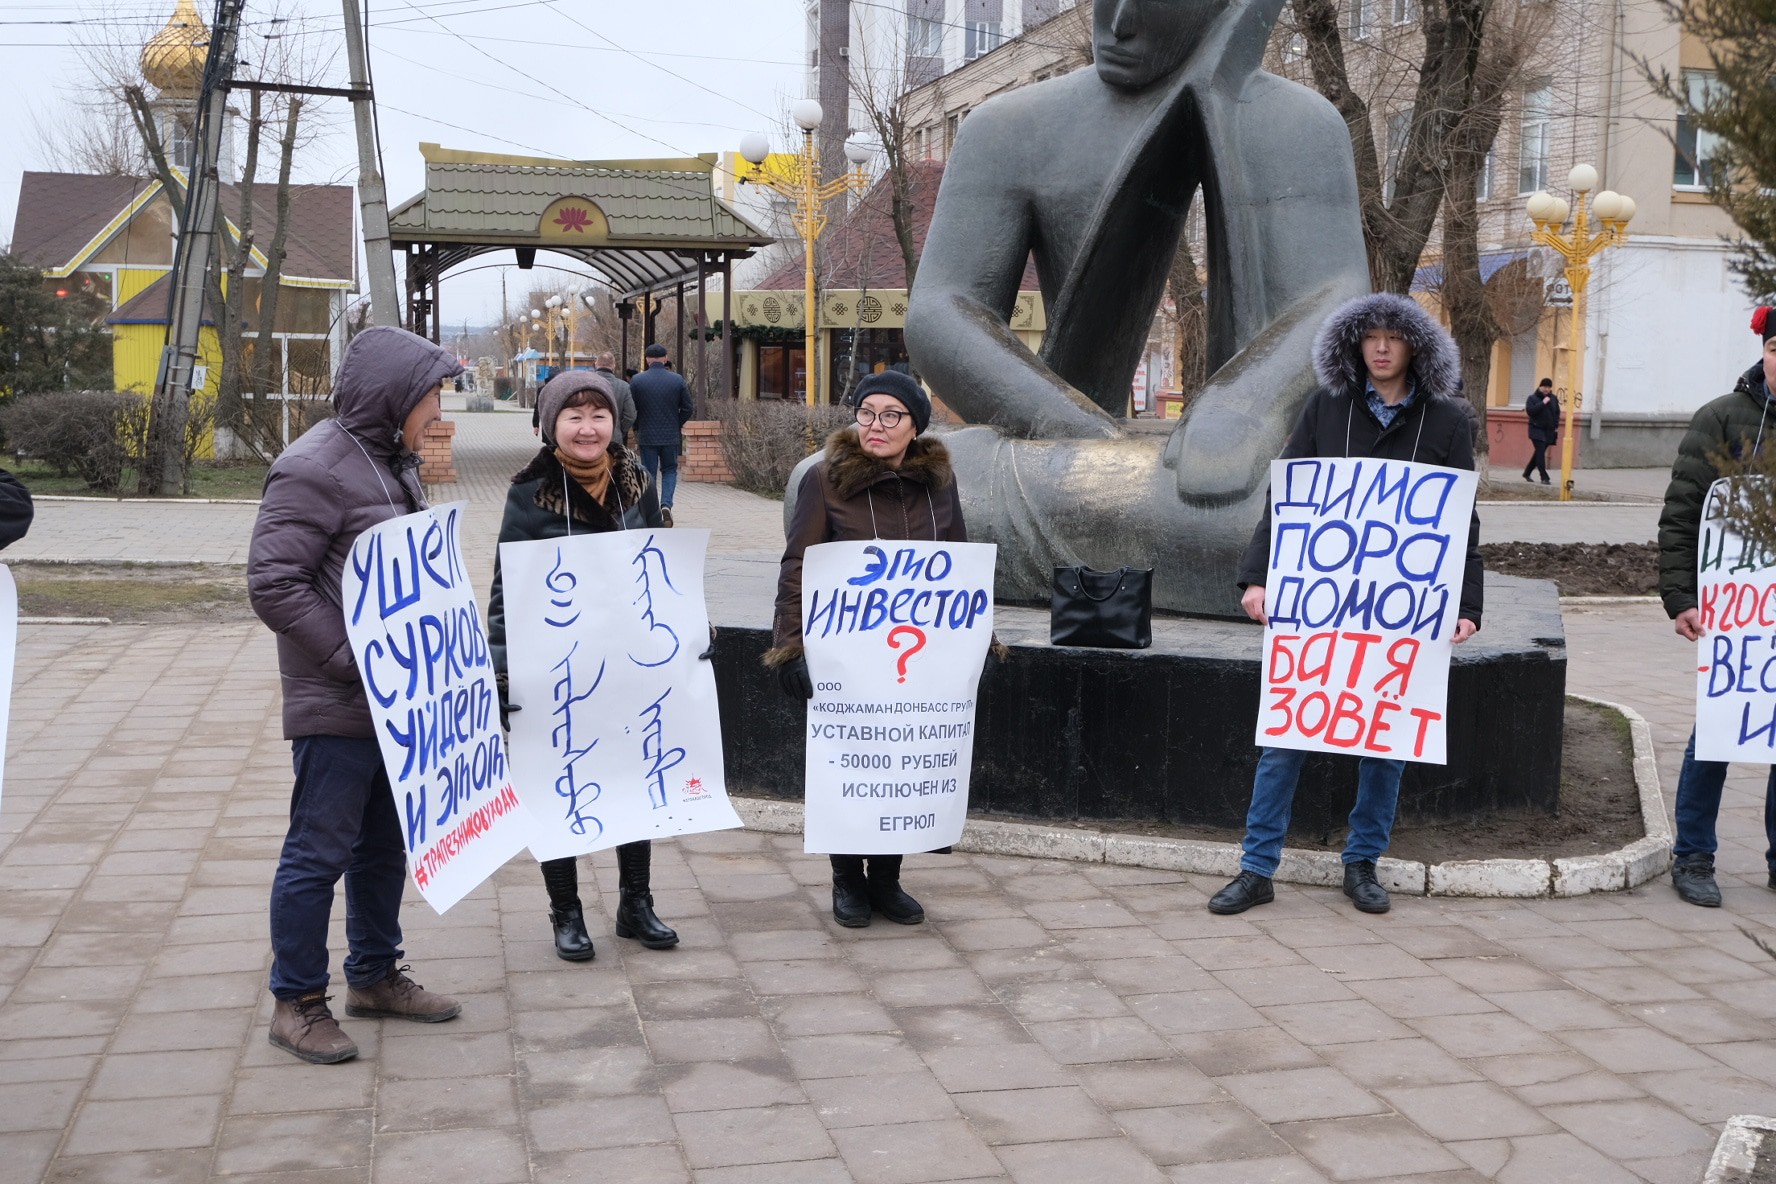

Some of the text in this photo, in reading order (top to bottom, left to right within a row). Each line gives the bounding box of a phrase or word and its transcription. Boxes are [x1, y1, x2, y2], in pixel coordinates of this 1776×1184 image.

[1275, 461, 1458, 529] ДИМА
[847, 546, 952, 586] ЭТО
[1272, 520, 1450, 586] ПОРА
[805, 588, 988, 639] ИНВЕСТОР
[1268, 576, 1449, 641] ДОМОЙ
[365, 600, 490, 708] СУРКОВ,
[887, 625, 926, 684] ?
[1269, 630, 1420, 696] БАТЯ
[813, 702, 948, 715] «КОДЖАМАНДОНБАСС
[817, 682, 842, 691] ООО
[386, 677, 491, 782] УЙДЁТ
[811, 723, 914, 742] УСТАВНОЙ
[1265, 687, 1441, 757] ЗОВЁТ
[840, 754, 891, 769] 50000
[902, 750, 957, 770] РУБЛЕЙ
[842, 778, 957, 798] ИСКЛЮЧЕН ИЗ
[406, 734, 504, 852] И ЭТОТ
[879, 813, 935, 831] ЕГРЮЛ
